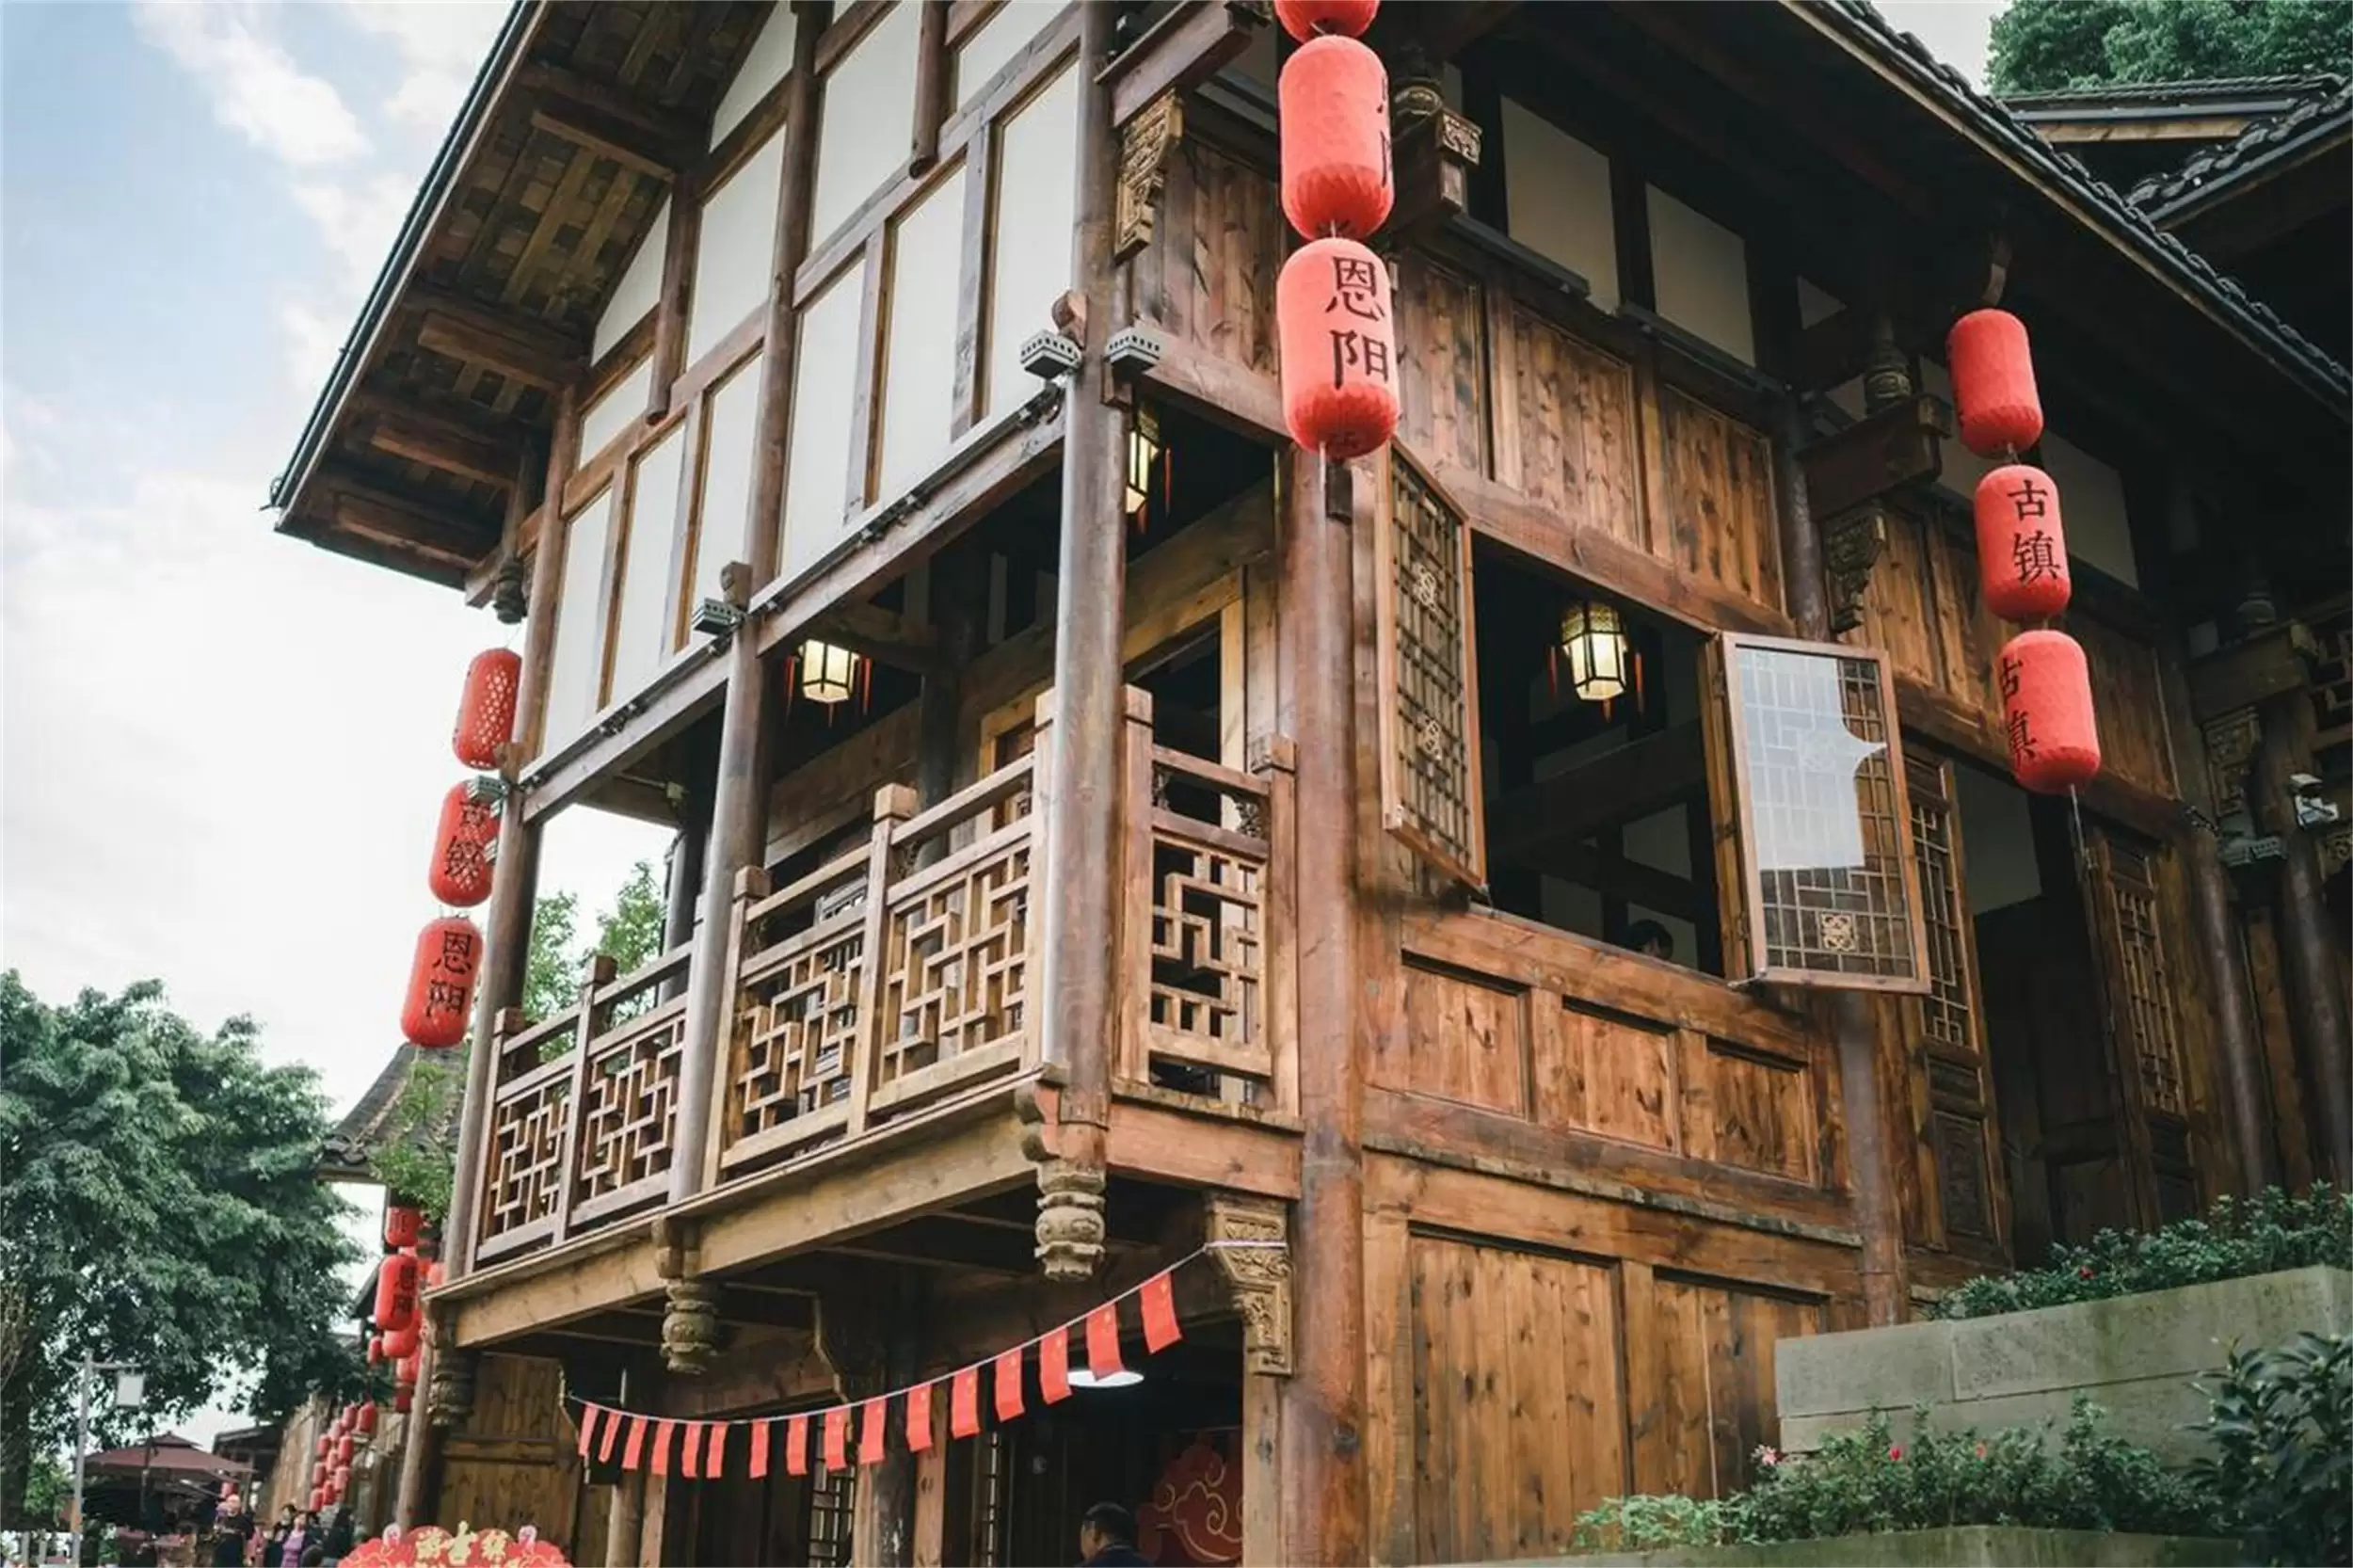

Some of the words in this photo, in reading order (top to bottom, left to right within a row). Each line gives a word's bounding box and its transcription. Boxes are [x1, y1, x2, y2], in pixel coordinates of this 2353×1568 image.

[1325, 256, 1389, 391] 恩阳
[2007, 479, 2061, 584] 古镇
[426, 930, 472, 1017] 恩阳
